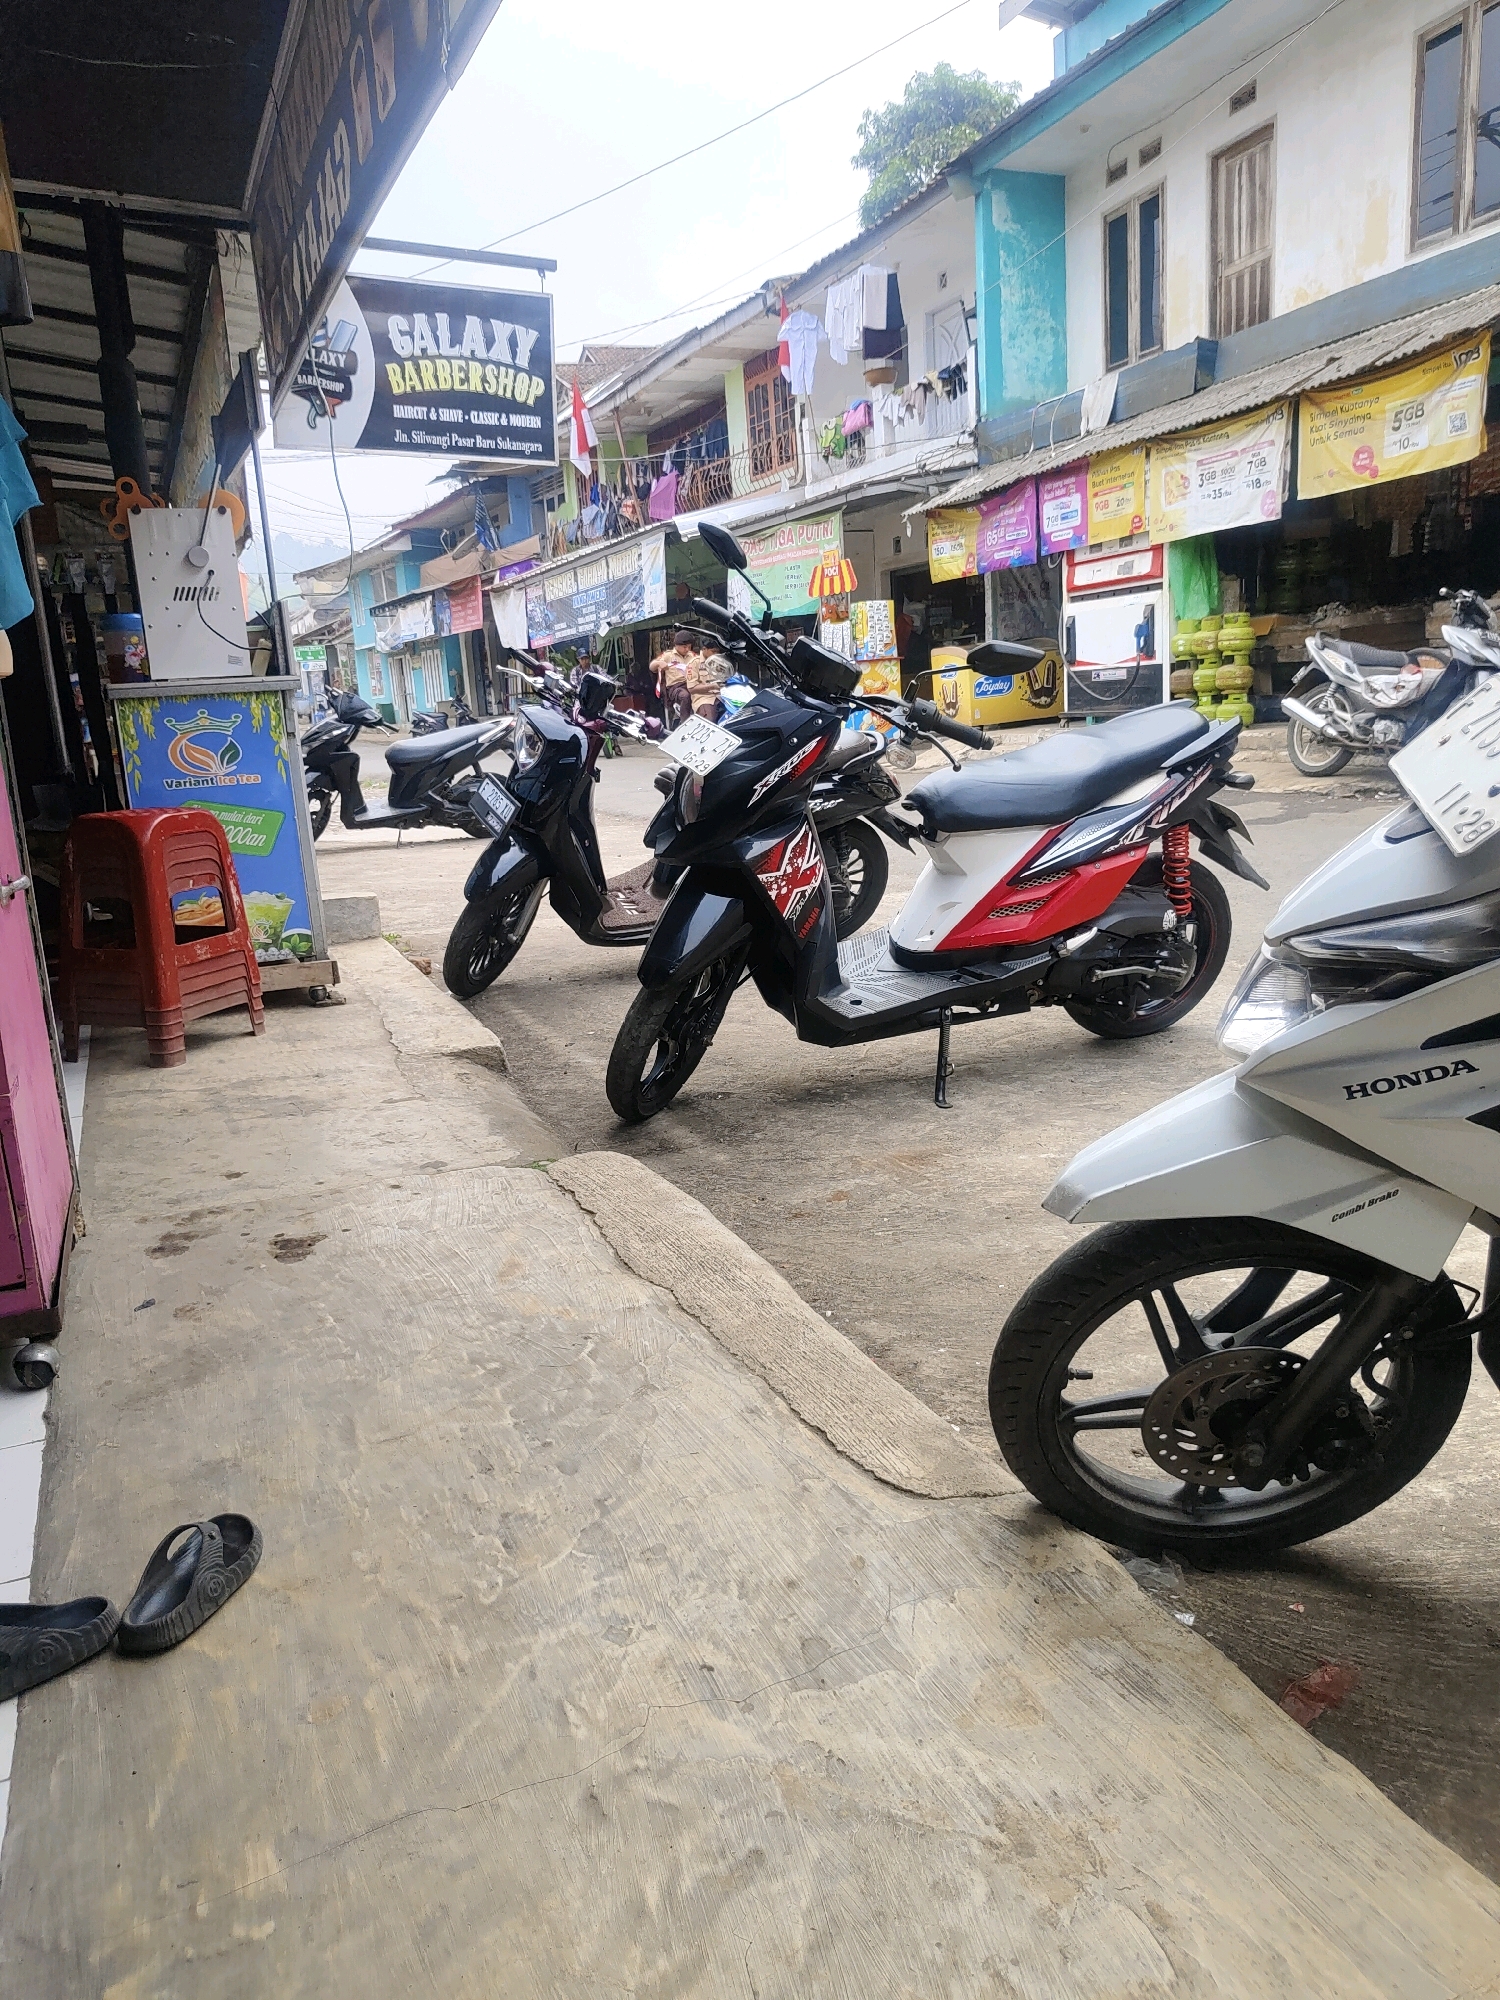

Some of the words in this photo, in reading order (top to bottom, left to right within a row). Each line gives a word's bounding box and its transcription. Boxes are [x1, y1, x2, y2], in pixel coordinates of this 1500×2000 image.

[387, 312, 540, 370] GALAXY
[303, 347, 346, 368] ALAXY
[385, 359, 545, 407] BARBERSHOP
[393, 404, 427, 421] HAIRCUT
[429, 408, 437, 420] &
[438, 408, 464, 423] SHAVE
[470, 410, 500, 426] CLASSIC
[501, 414, 508, 426] &
[509, 413, 542, 429] MODERN
[1310, 407, 1338, 423] Simpel
[1340, 396, 1380, 414] Kuotanya
[1329, 412, 1371, 429] Sinyalnya
[1391, 402, 1425, 432] 5GB
[394, 429, 411, 444] Jln.
[411, 430, 451, 450] Siliwangi
[451, 434, 475, 448] Pasar
[475, 435, 496, 449] Baru
[497, 437, 542, 455] Sukanagara
[1333, 426, 1365, 441] Semua
[1247, 456, 1267, 475] 7GB
[797, 517, 835, 547] PUTRI
[824, 566, 839, 578] POCI
[975, 680, 1011, 695] Joyday
[164, 777, 216, 790] Variant
[217, 775, 237, 786] Ice
[237, 773, 261, 785] Tea
[481, 781, 490, 794] F
[220, 810, 243, 823] mulai
[243, 813, 265, 825] dari
[798, 907, 821, 939] YAMAHA
[1342, 1059, 1481, 1101] HONDA
[1331, 1202, 1366, 1223] Combi
[1367, 1188, 1400, 1208] Brake
